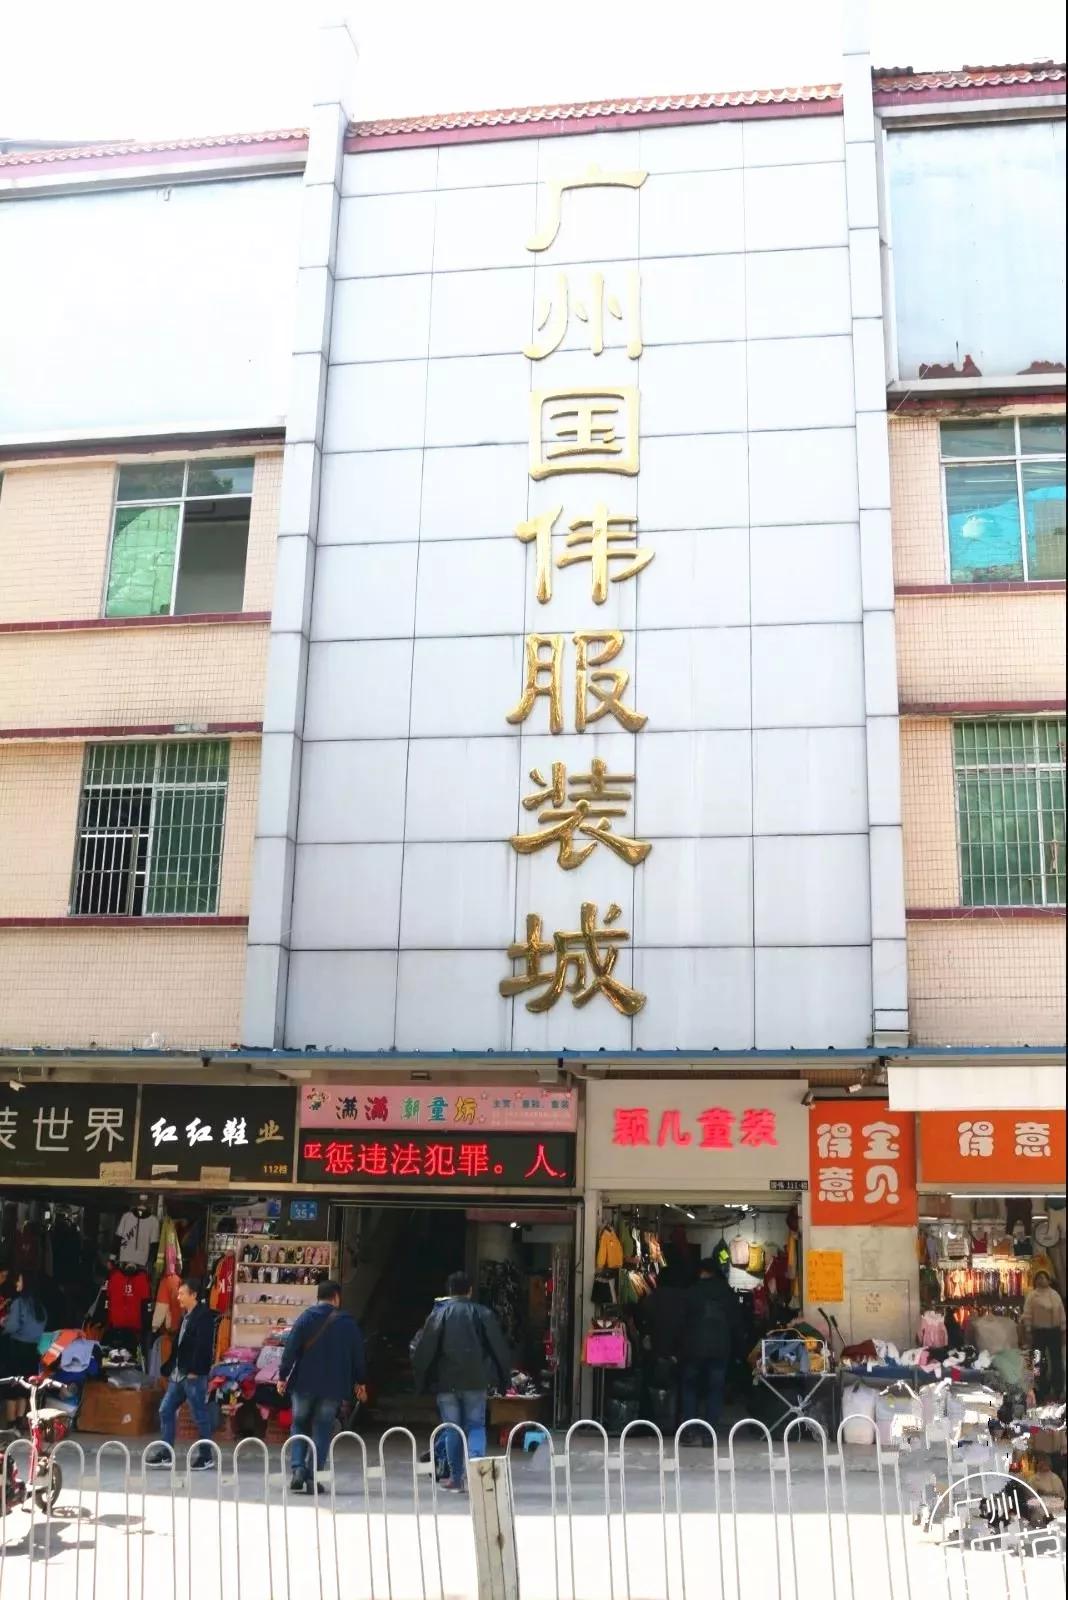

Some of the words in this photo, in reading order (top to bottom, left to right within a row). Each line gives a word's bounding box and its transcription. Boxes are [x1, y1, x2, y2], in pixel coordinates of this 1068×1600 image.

[499, 169, 655, 1016] 广州国伟服装城
[149, 1117, 285, 1148] 红红鞋业
[612, 1106, 778, 1149] 颖儿童装
[957, 1121, 1051, 1158] 得意
[304, 1142, 567, 1178] 严惩违法犯罪。人
